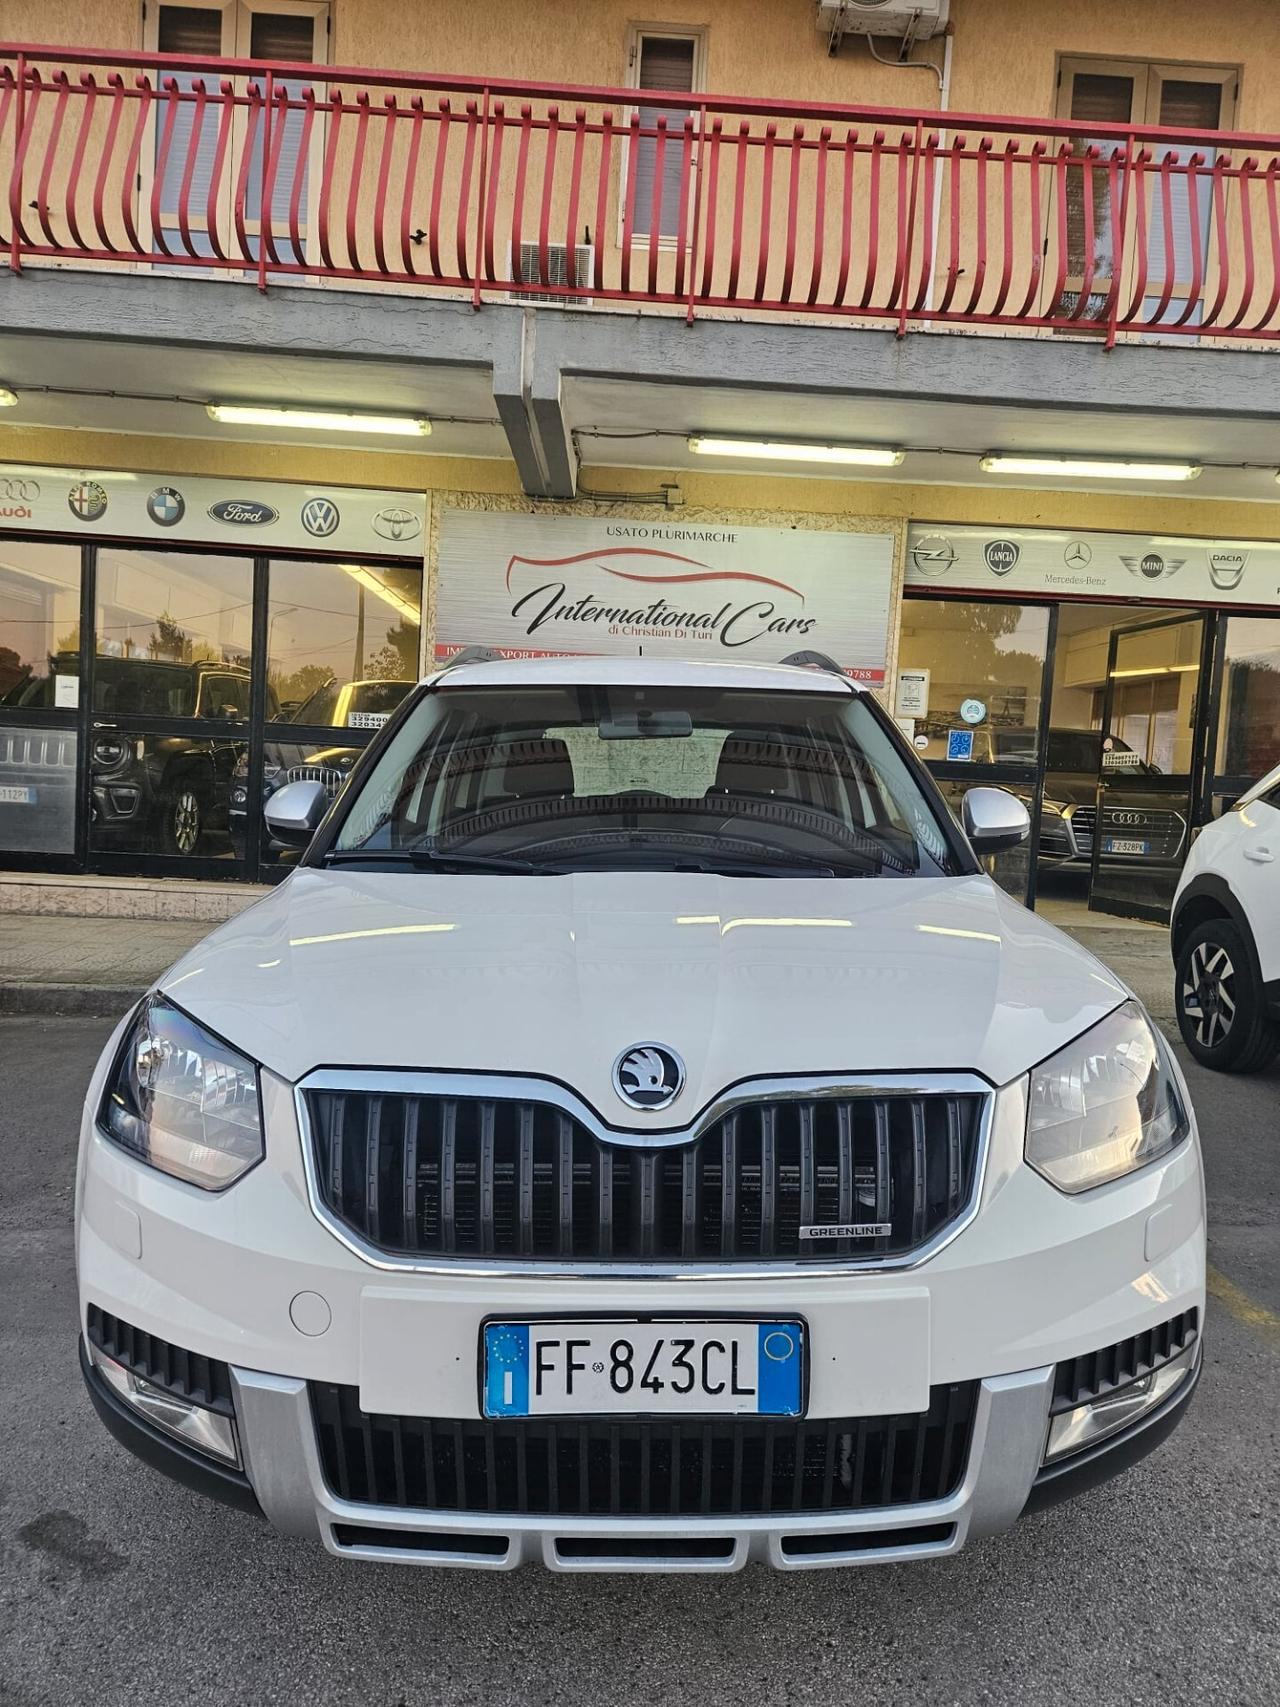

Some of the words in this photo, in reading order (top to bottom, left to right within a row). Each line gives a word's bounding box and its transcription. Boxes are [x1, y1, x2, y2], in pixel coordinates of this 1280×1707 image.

[150, 486, 182, 501] BMW
[223, 503, 262, 523] Ford
[606, 526, 649, 538] USATO
[651, 529, 738, 543] PLURIMARCHE
[989, 551, 1015, 562] LANCIA
[1212, 554, 1243, 562] DACIA
[1141, 561, 1163, 571] MINI
[1044, 574, 1107, 586] Mercedes-Benz
[511, 582, 723, 635] International
[719, 601, 818, 647] Cars
[608, 625, 619, 634] di
[622, 626, 671, 638] Christian
[674, 629, 688, 639] Di
[691, 631, 713, 640] Turi
[500, 650, 535, 660] XPORT
[809, 1226, 883, 1237] GREENLINE
[536, 1339, 591, 1395] FF
[610, 1339, 756, 1395] 843CL
